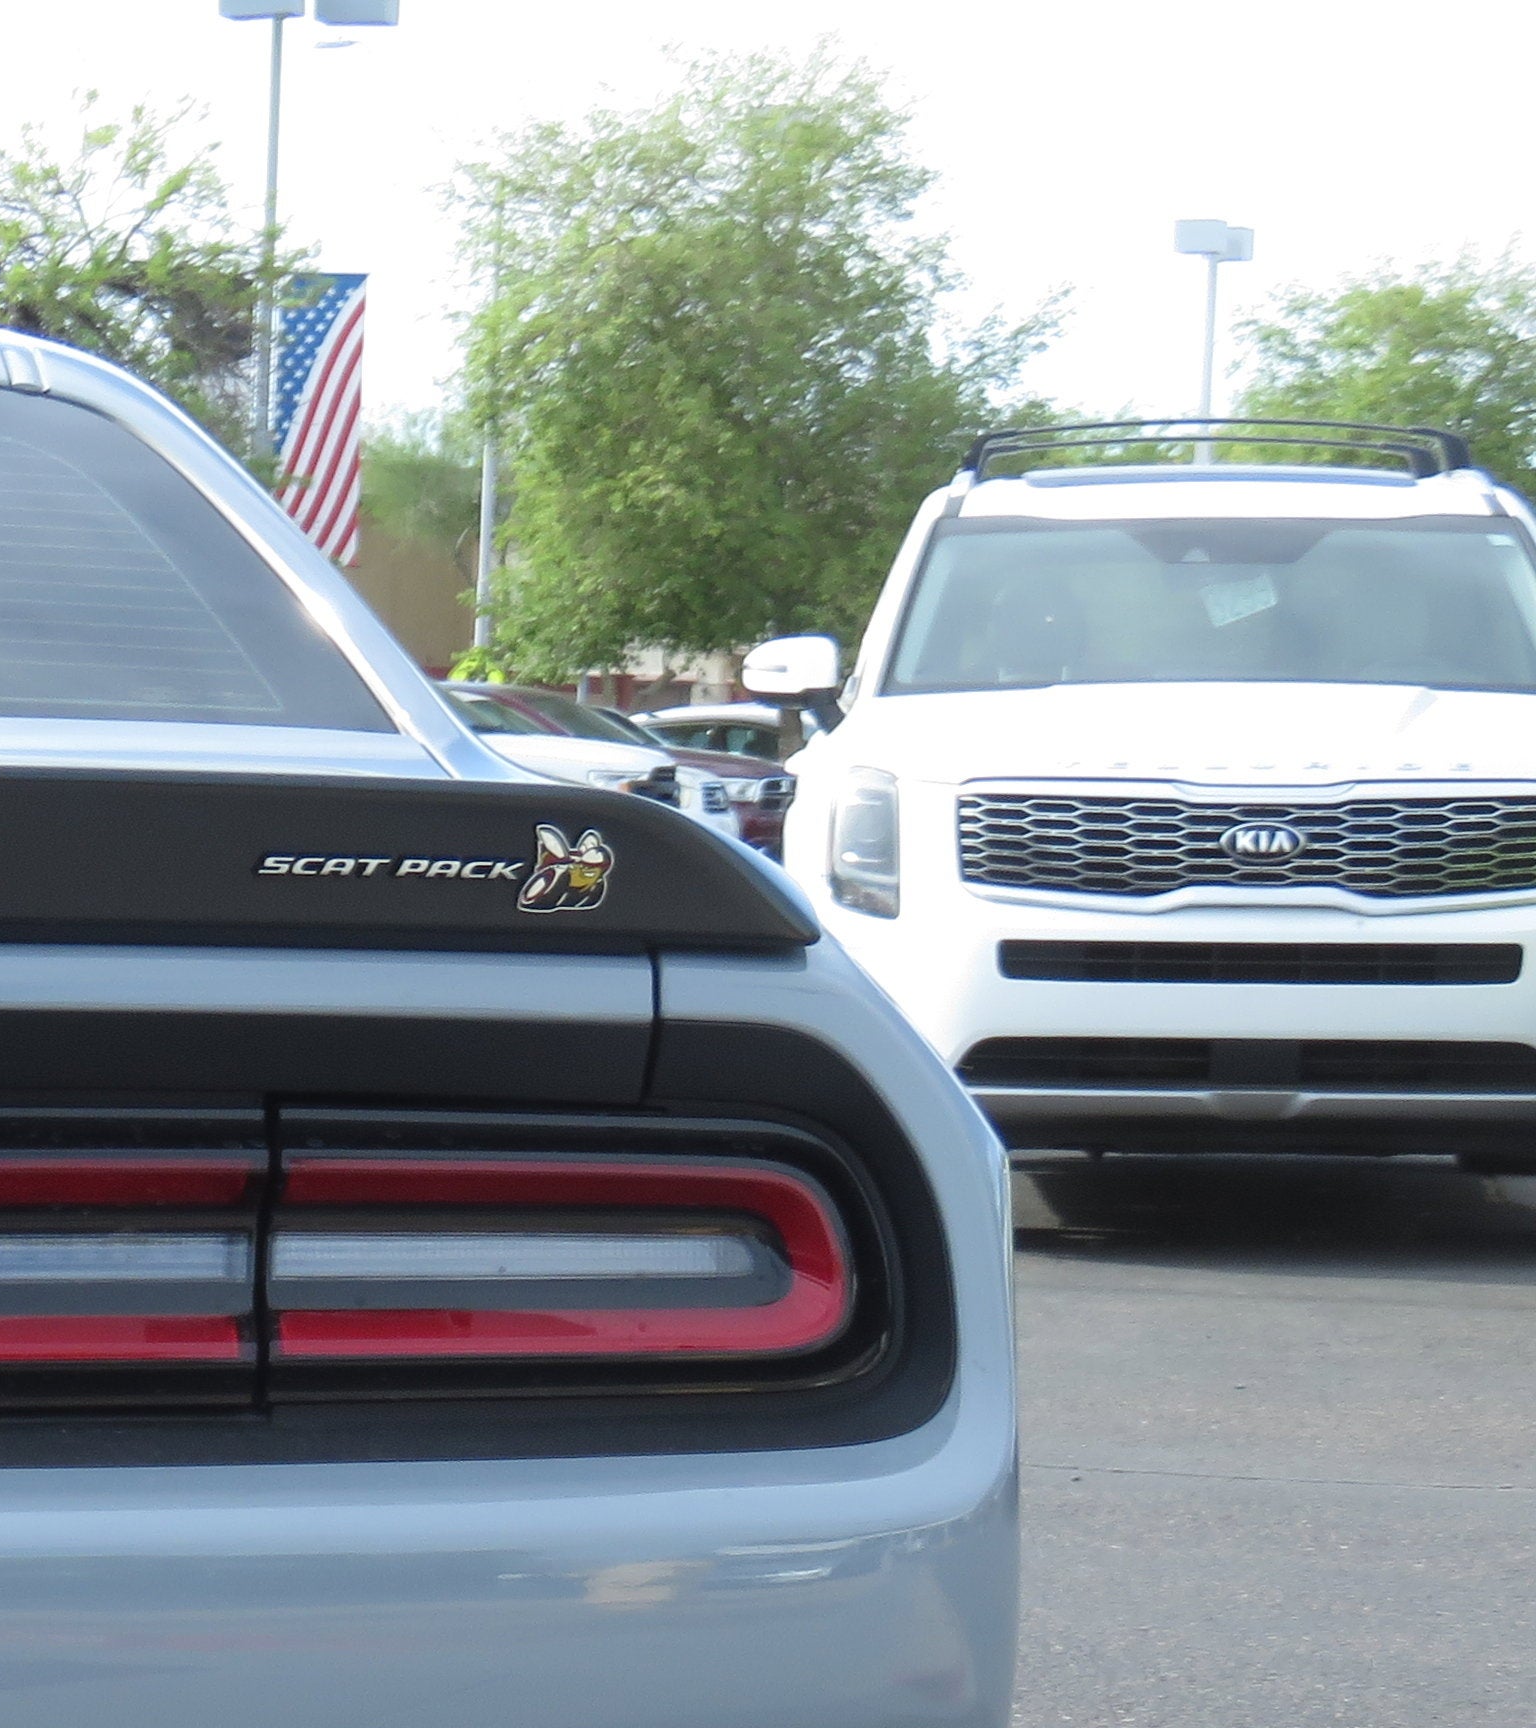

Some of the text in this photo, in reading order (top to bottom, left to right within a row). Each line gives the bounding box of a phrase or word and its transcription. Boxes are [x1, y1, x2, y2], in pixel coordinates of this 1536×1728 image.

[1235, 830, 1294, 854] KIA
[258, 856, 525, 880] SCAT PACK
